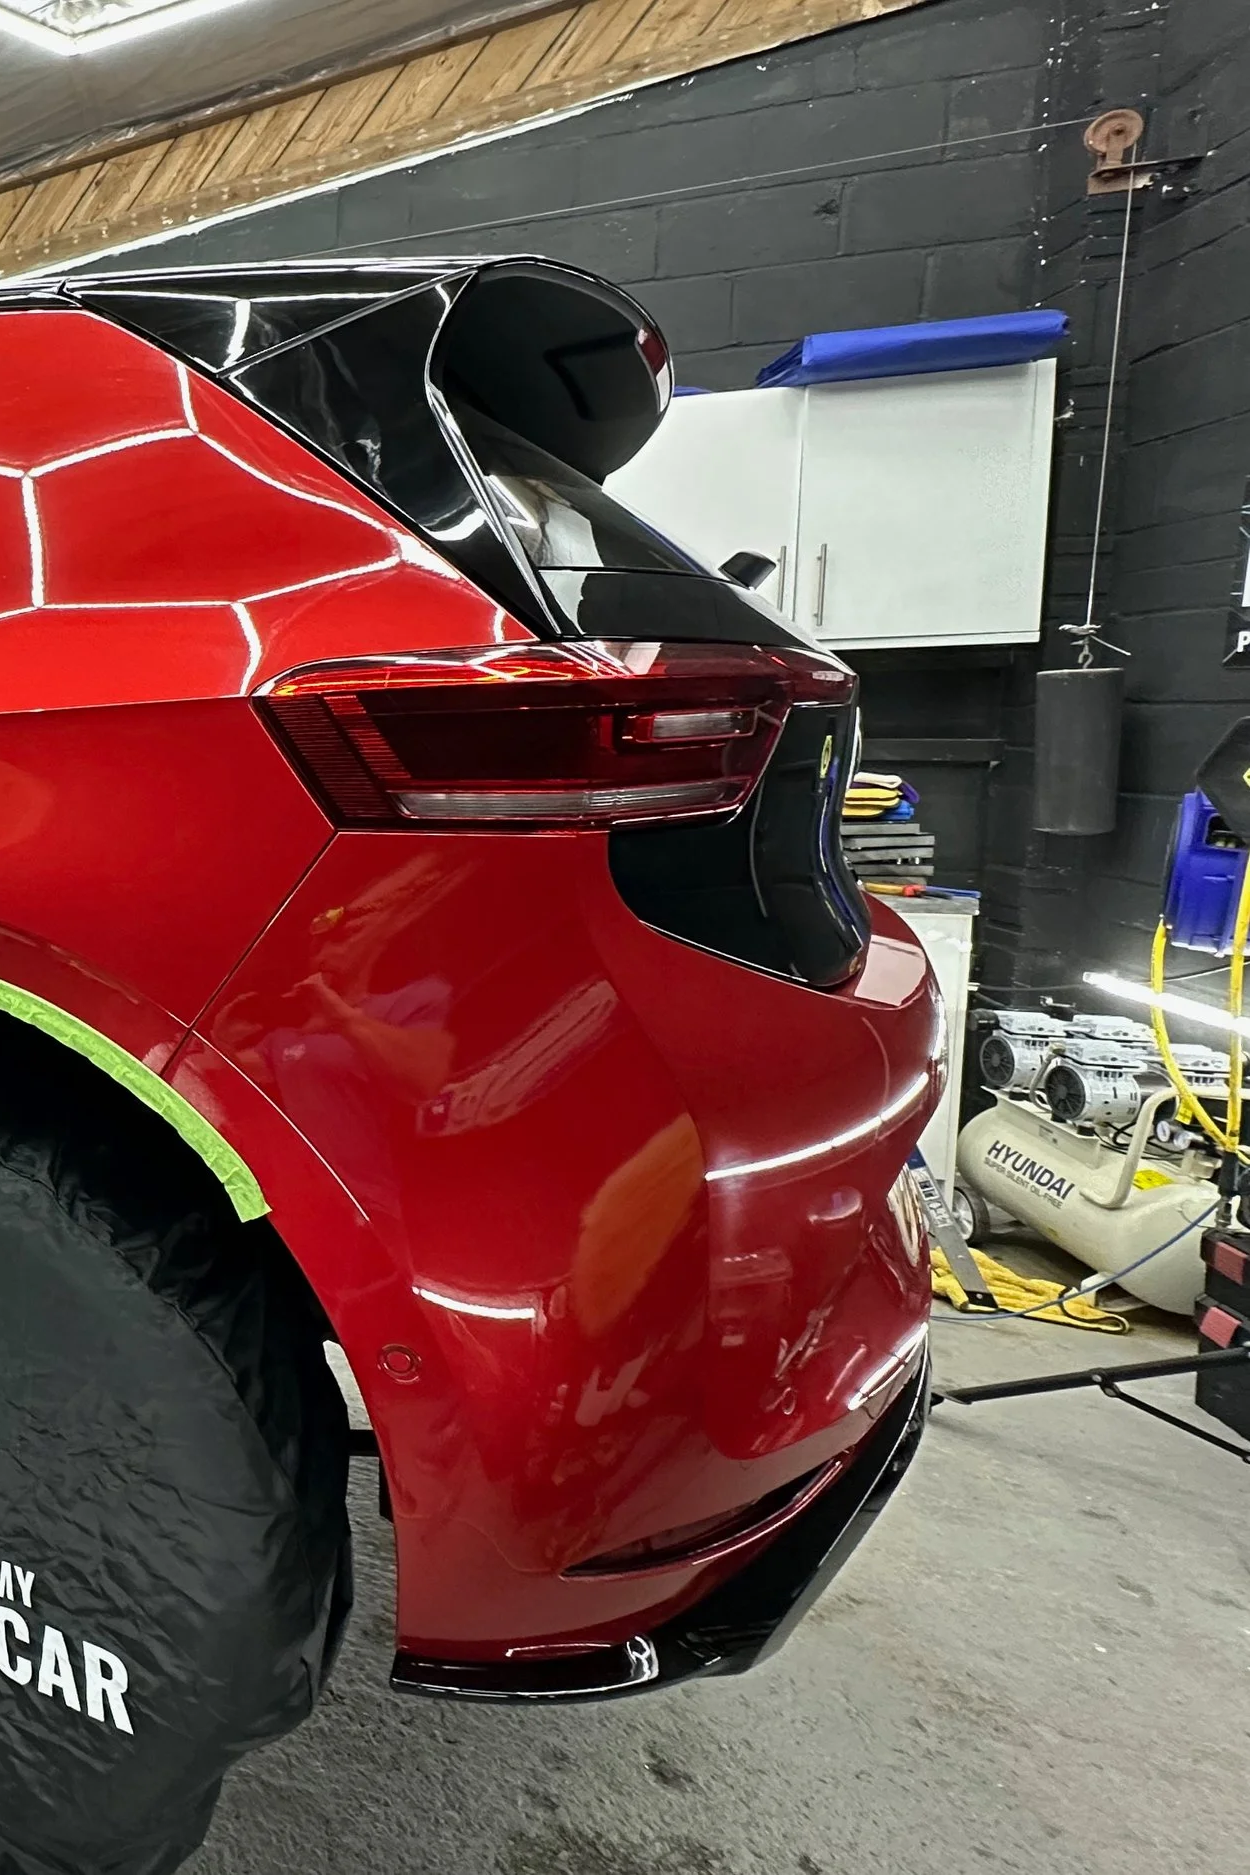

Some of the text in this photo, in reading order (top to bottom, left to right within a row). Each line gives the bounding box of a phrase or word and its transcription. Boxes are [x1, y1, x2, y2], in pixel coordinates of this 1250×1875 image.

[984, 1157, 1063, 1210] SUPER SILENT OIL-FREE
[987, 1140, 1075, 1200] HYUNDAI
